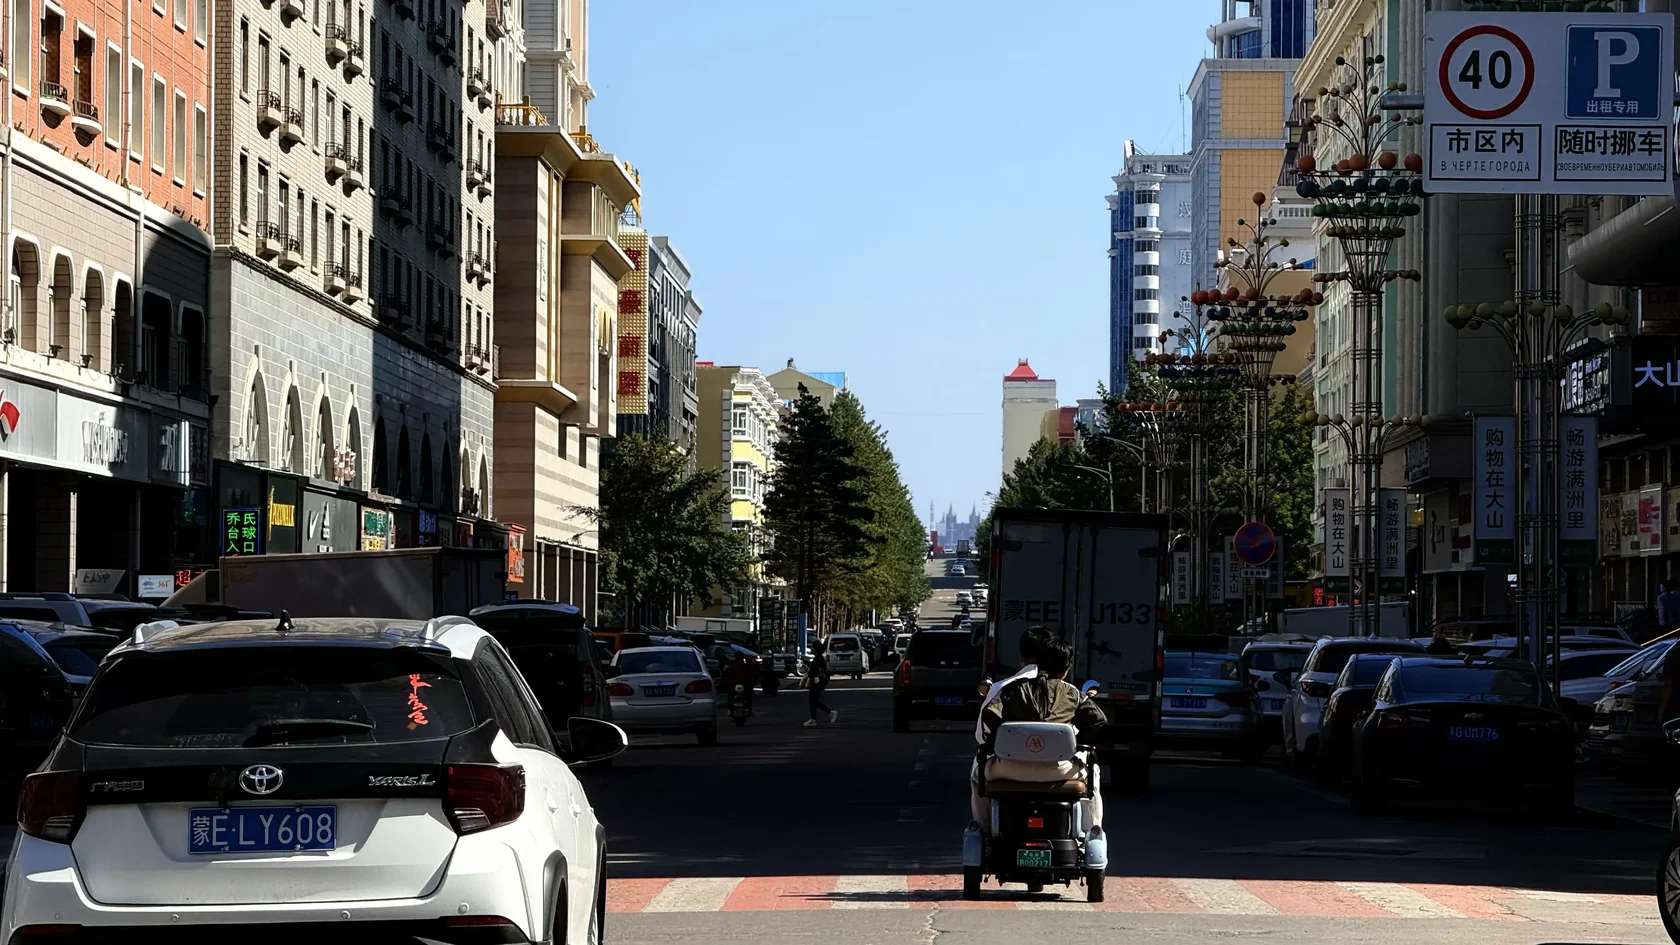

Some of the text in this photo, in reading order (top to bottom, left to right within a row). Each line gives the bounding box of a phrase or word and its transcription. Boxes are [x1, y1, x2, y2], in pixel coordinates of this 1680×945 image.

[1458, 50, 1512, 90] 40
[1593, 31, 1640, 98] P
[1586, 100, 1639, 114] 出租专用
[1446, 128, 1524, 154] 市区内
[1559, 129, 1663, 156] 随时挪车
[1485, 428, 1504, 528] 购物在大山
[1566, 428, 1585, 529] 畅游满洲里
[226, 512, 256, 525] 乔氏
[226, 541, 255, 553] 入口
[227, 527, 256, 540] 台球
[1332, 498, 1345, 569] 购物在大山
[1386, 498, 1398, 569] 畅游满洲里
[1004, 600, 1151, 624] 蒙EE J133
